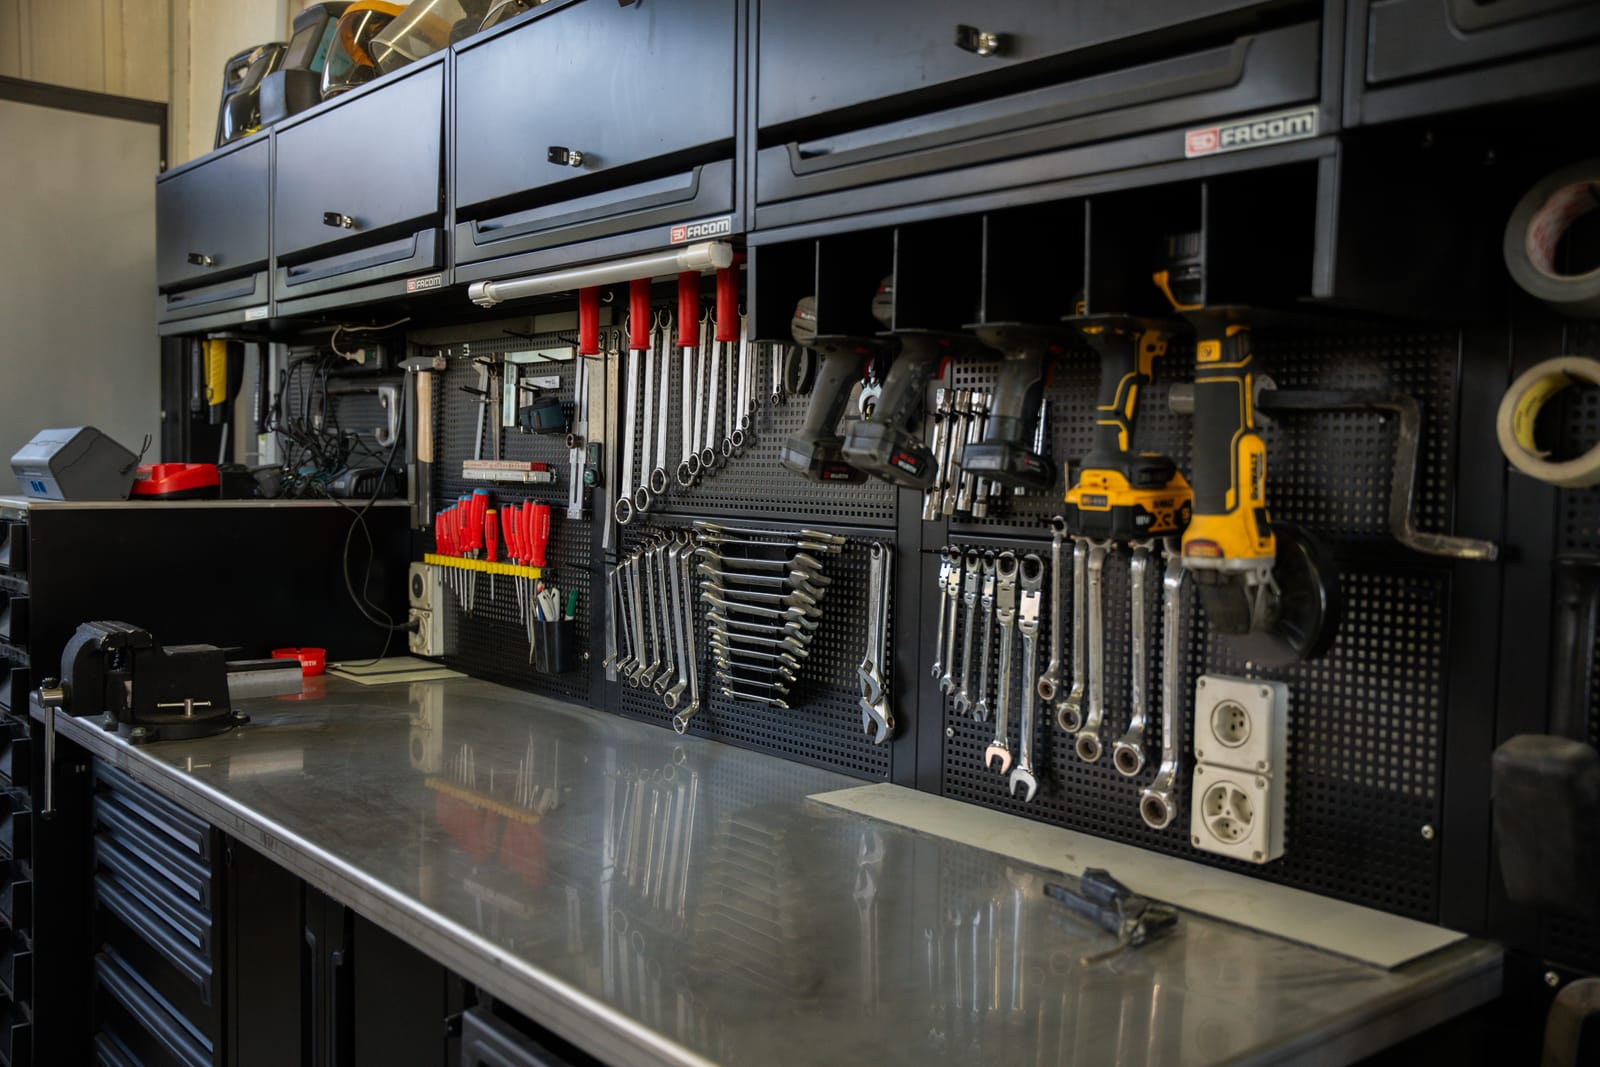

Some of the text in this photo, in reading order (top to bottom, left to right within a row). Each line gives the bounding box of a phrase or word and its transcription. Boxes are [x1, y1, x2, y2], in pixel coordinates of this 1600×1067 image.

[1221, 114, 1313, 147] FACOM
[687, 220, 729, 238] FACOM
[416, 276, 441, 289] FACOM
